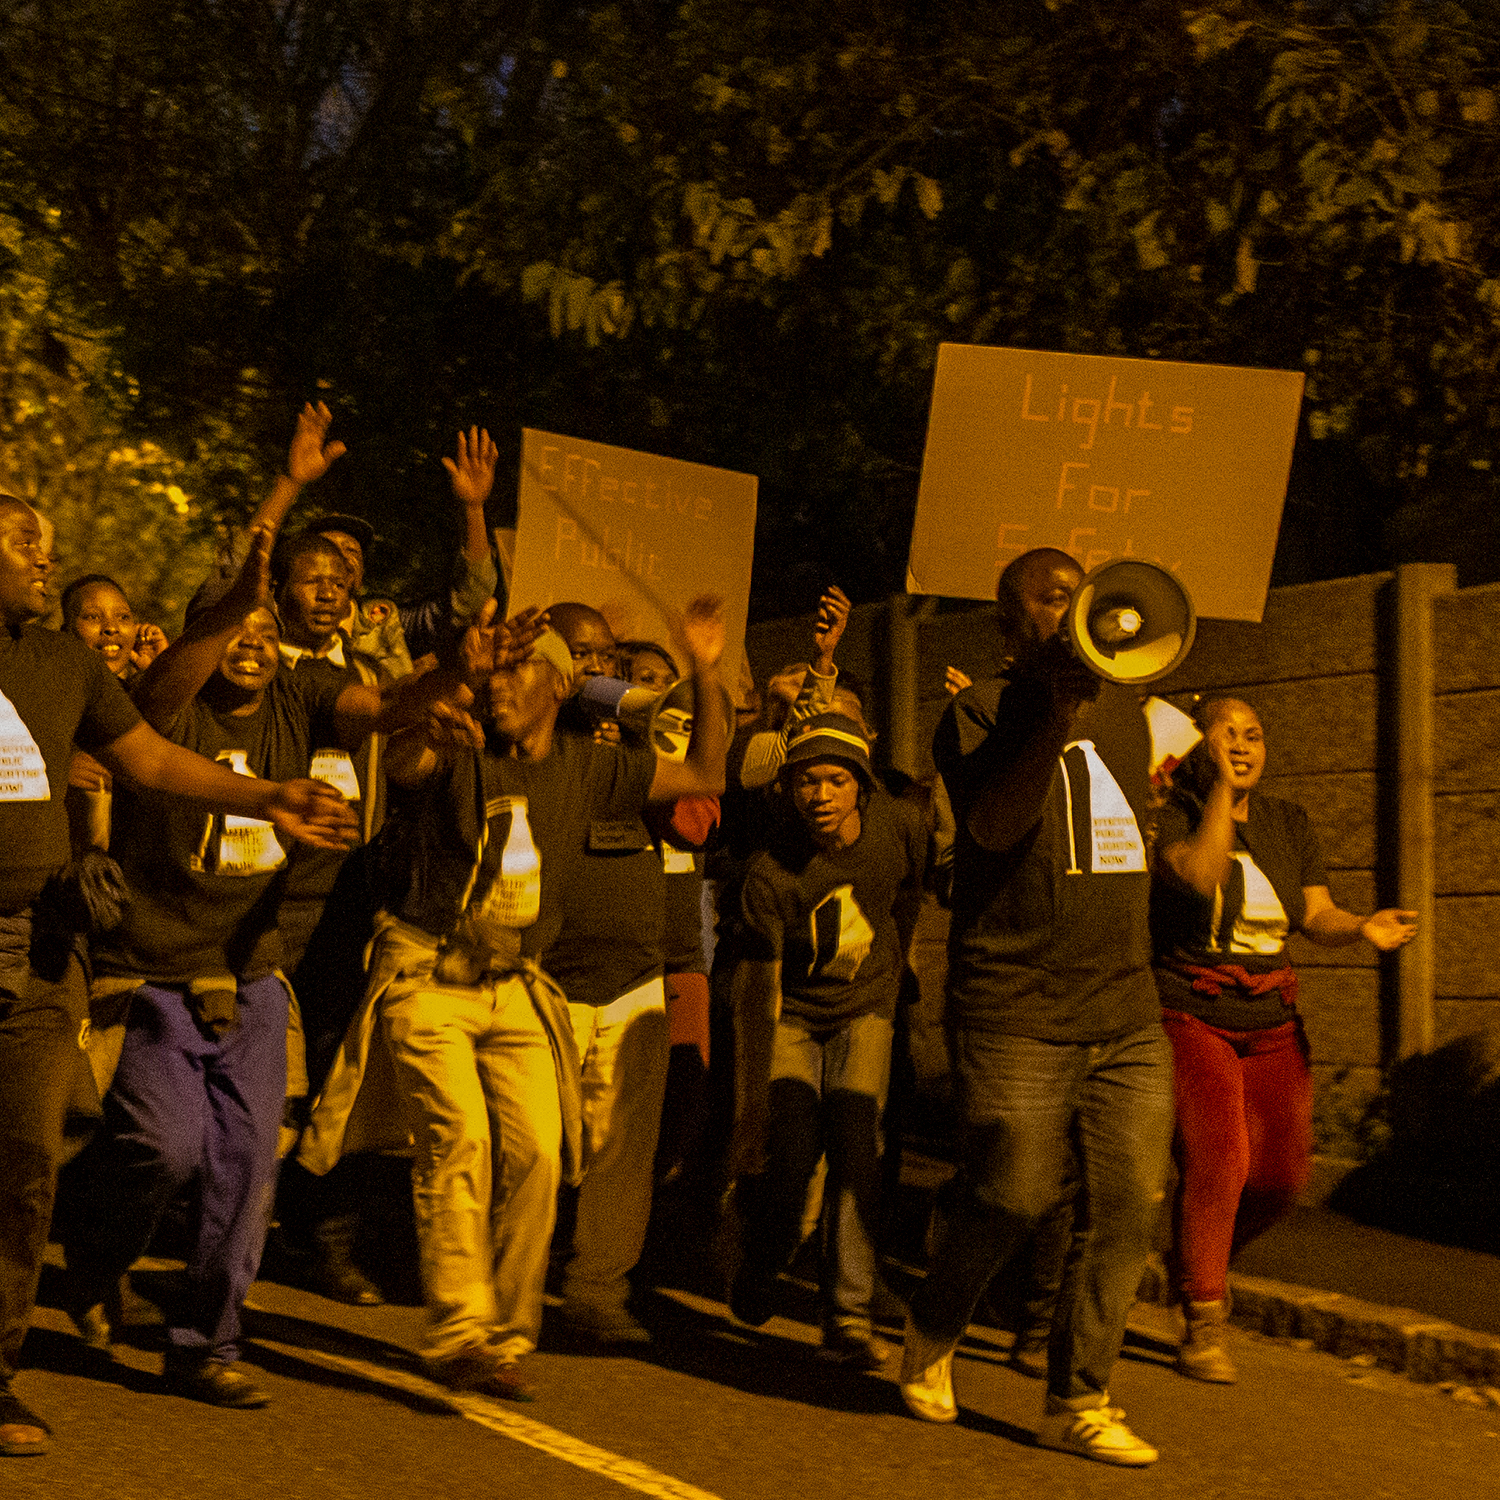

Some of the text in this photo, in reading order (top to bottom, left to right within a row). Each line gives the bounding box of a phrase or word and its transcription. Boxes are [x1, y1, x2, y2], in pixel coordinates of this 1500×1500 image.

[1021, 374, 1194, 450] Lights
[1056, 462, 1151, 513] For
[555, 515, 662, 582] Public
